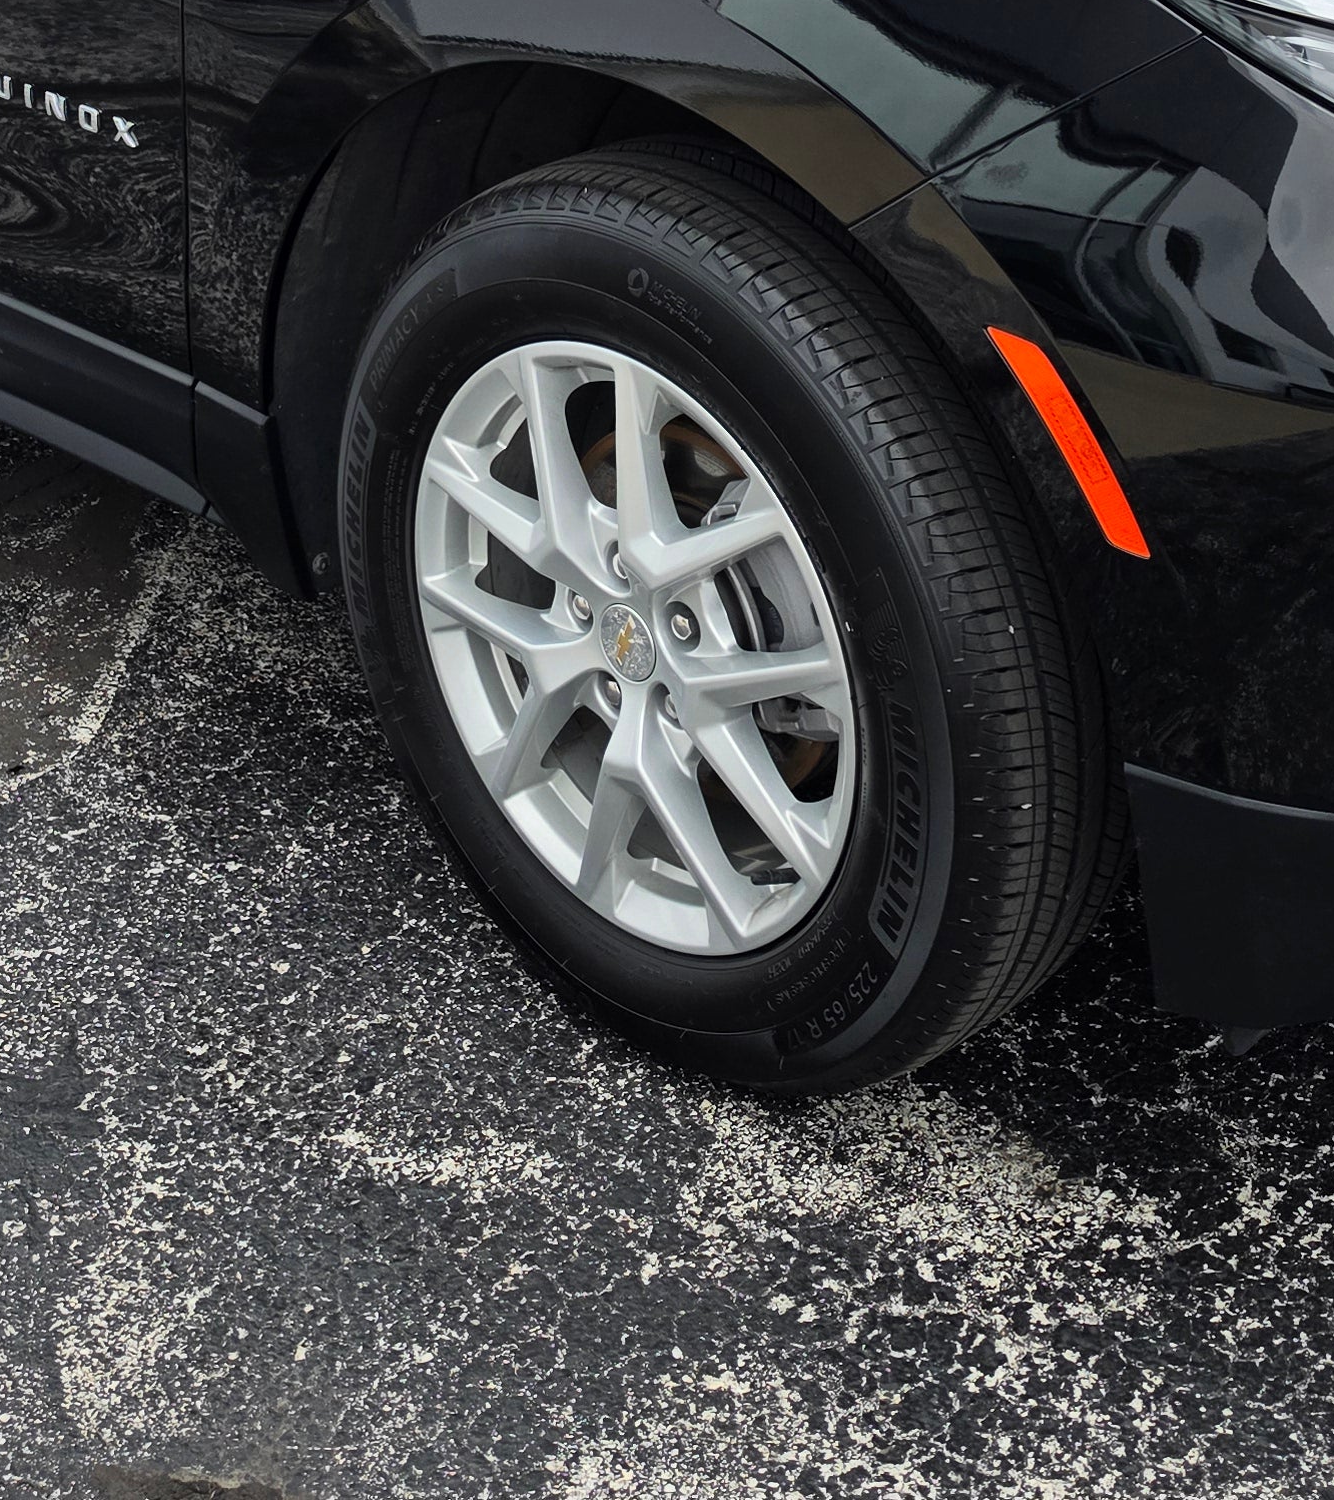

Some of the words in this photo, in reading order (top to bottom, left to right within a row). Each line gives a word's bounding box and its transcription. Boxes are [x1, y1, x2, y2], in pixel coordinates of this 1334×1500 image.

[344, 406, 374, 616] MICHELIN
[876, 700, 923, 944] MICHELIN
[805, 1017, 824, 1040] R
[822, 961, 878, 1029] 225/65
